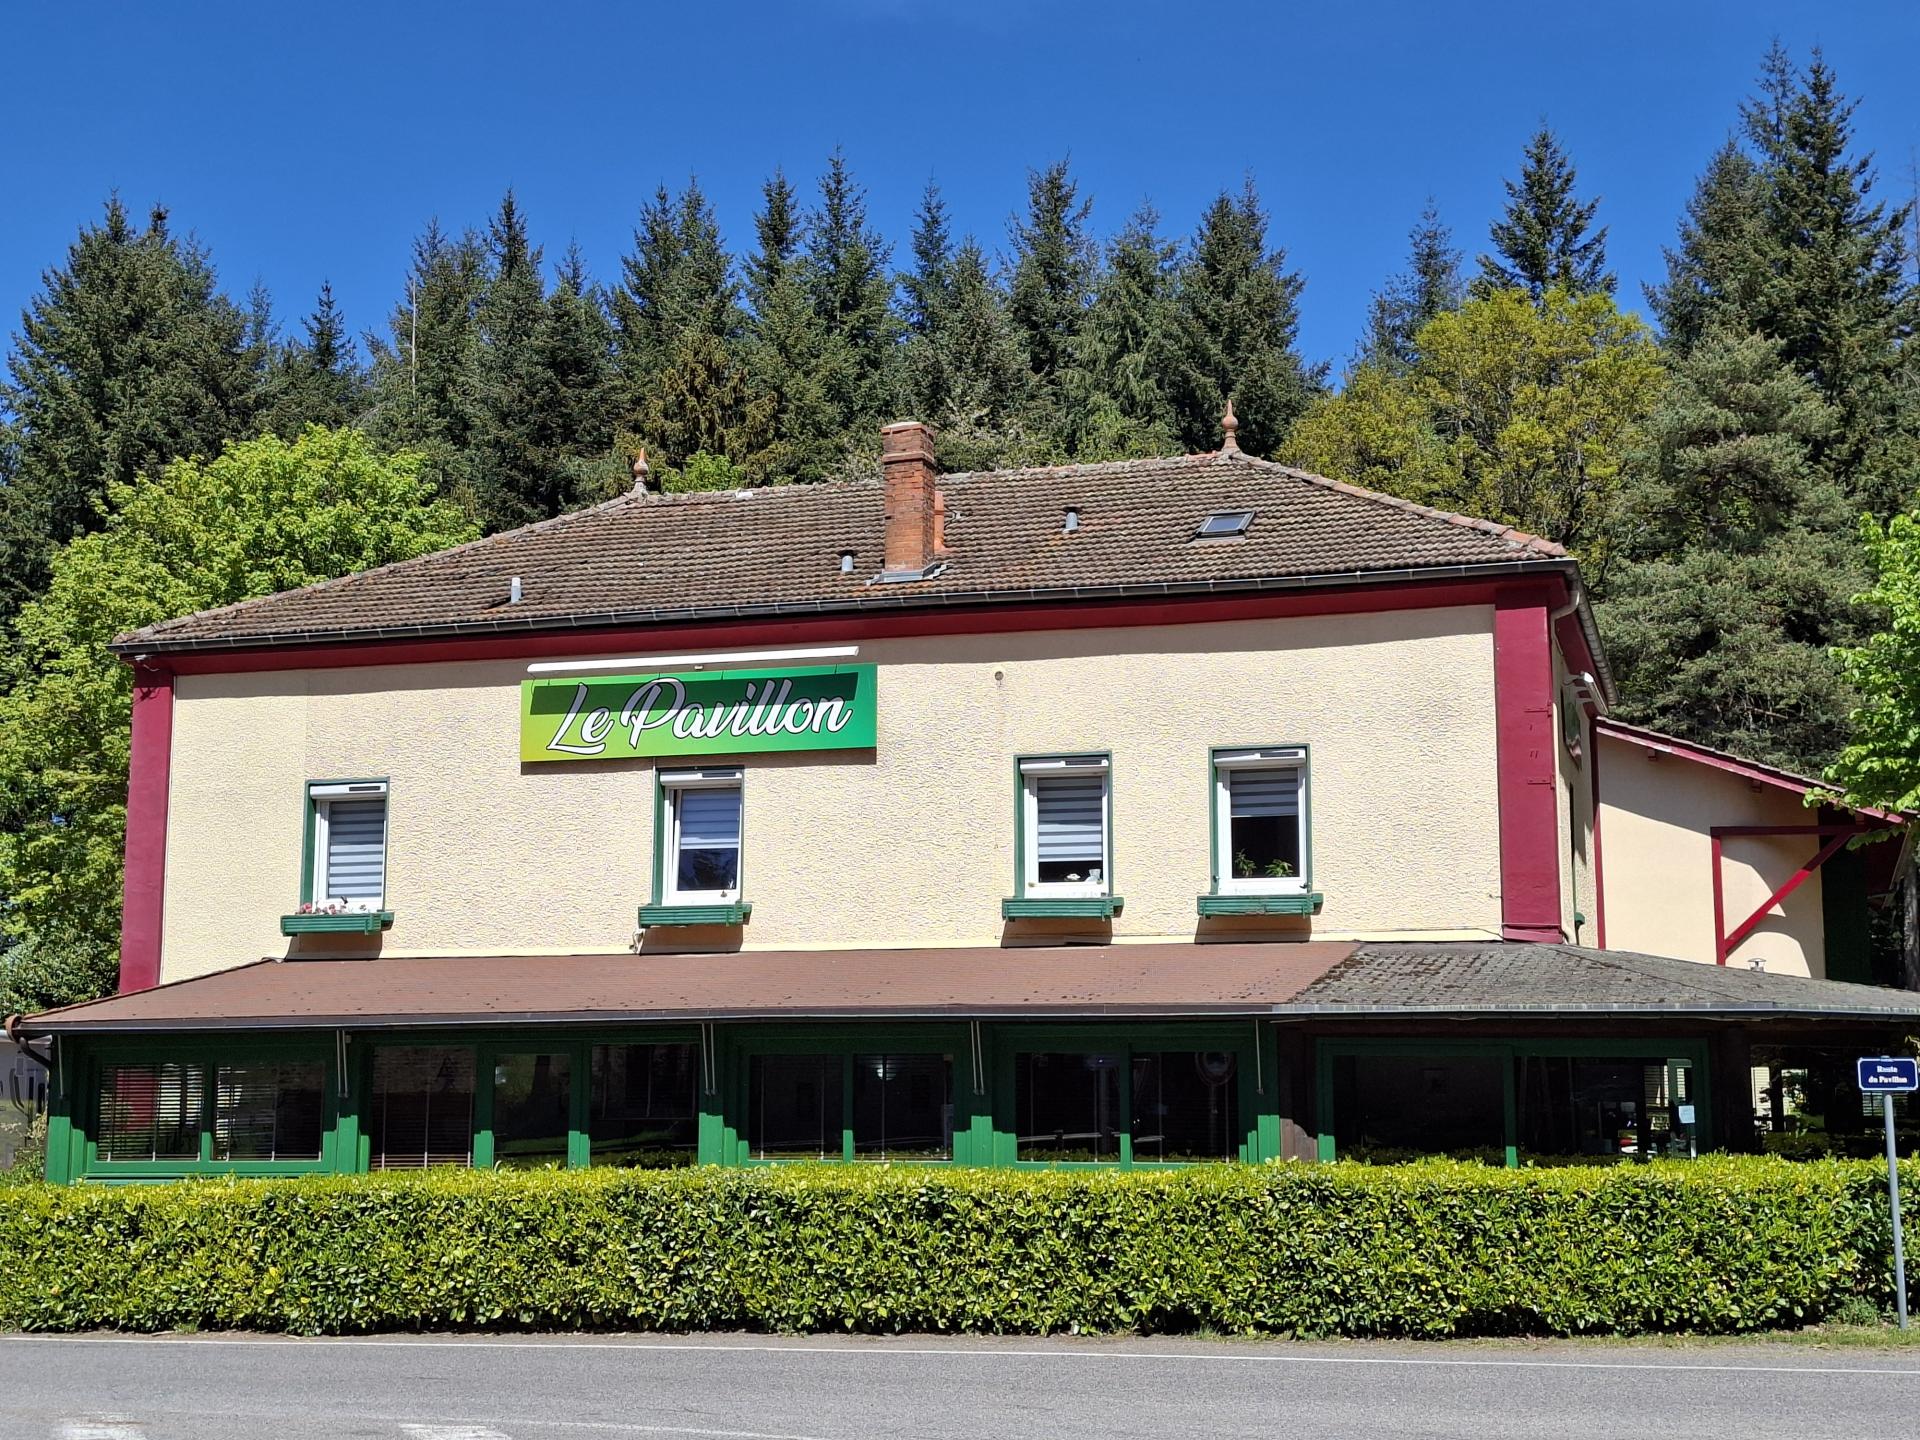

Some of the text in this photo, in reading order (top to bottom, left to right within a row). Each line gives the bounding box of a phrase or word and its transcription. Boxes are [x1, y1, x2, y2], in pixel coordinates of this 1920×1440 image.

[546, 677, 853, 755] Le Pavillon
[1868, 1075, 1908, 1083] du Pavillon
